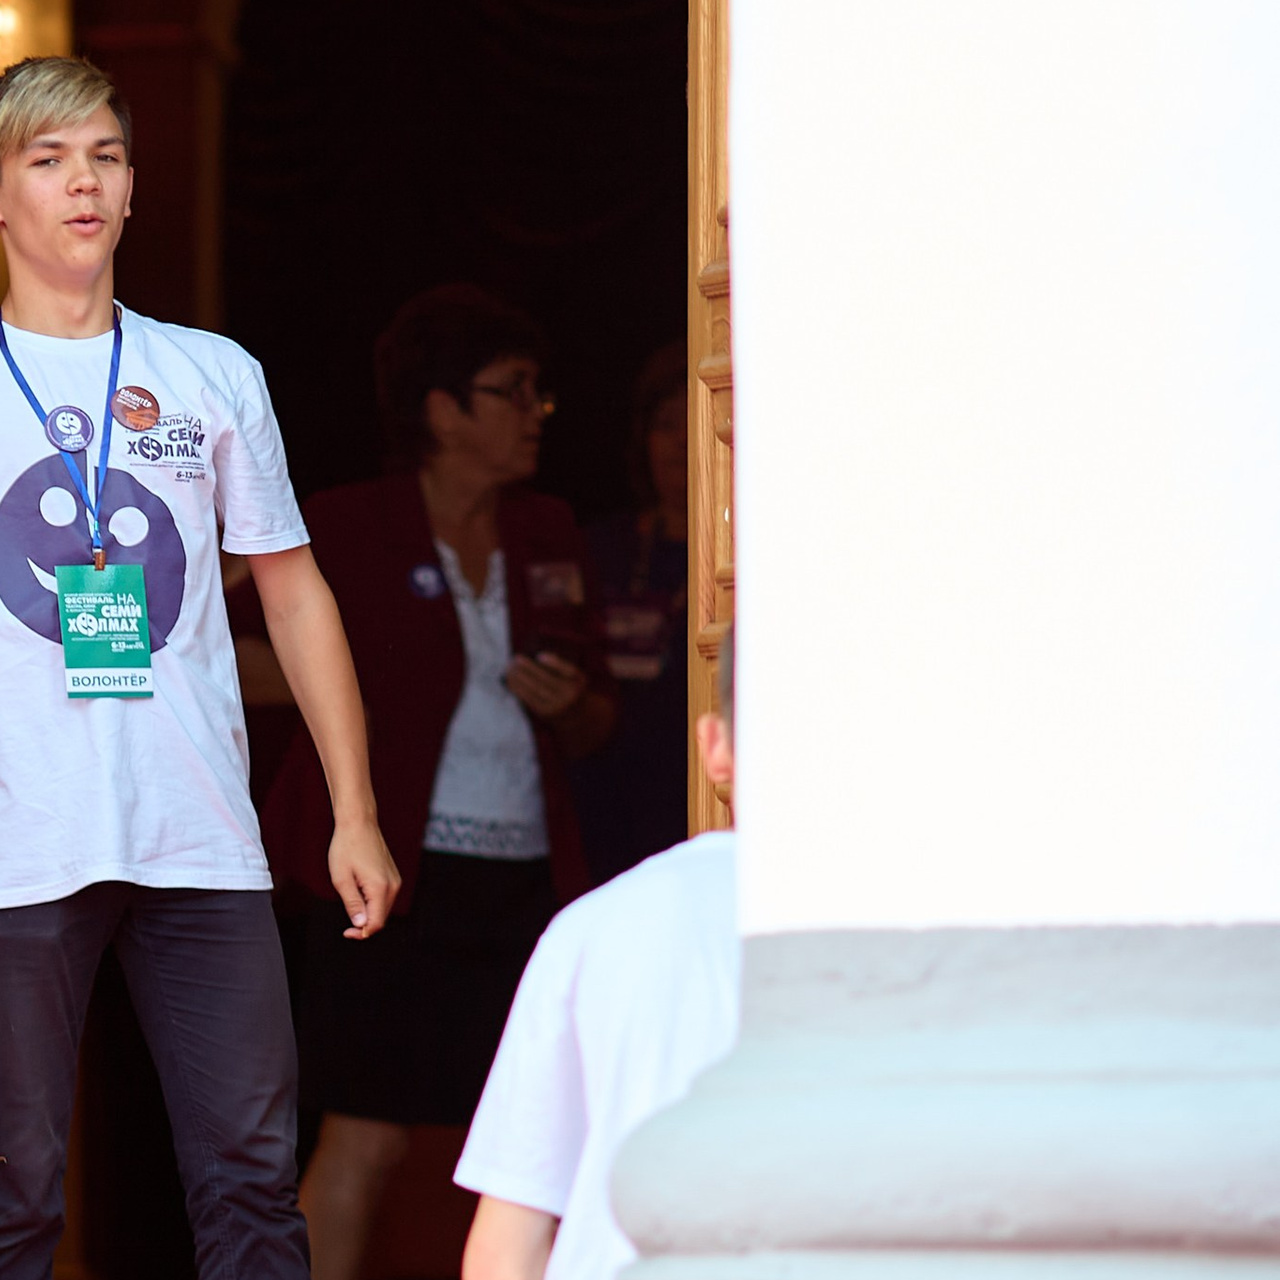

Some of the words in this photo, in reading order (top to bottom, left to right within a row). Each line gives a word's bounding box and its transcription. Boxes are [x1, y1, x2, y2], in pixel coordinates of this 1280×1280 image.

[64, 596, 115, 604] ФЕСТИВАЛЬ
[116, 593, 137, 605] НА
[101, 604, 142, 618] СЕМИ
[72, 673, 147, 687] ВОЛОНТЁР
